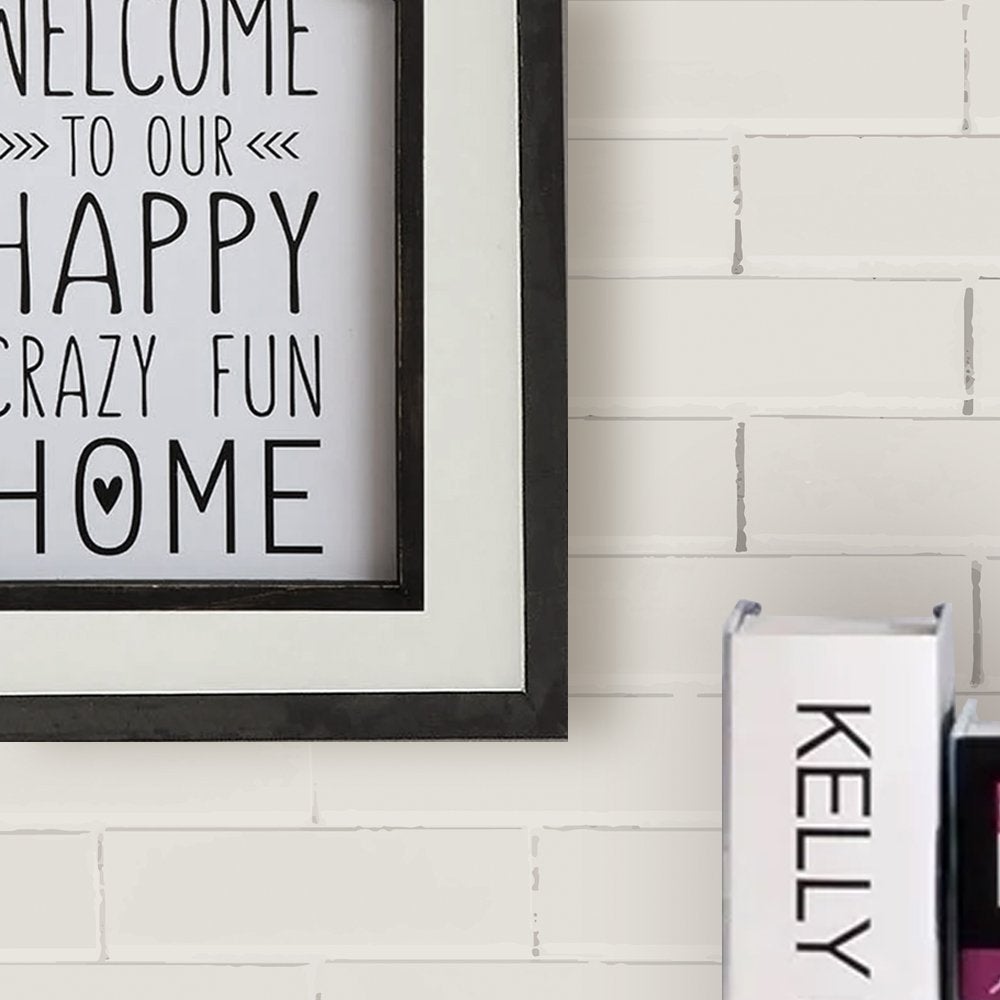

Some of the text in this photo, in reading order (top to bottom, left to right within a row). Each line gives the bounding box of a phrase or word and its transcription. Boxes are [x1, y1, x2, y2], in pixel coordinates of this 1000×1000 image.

[61, 115, 233, 177] TO OUR
[212, 334, 321, 418] FUN
[795, 704, 872, 978] KELLY
